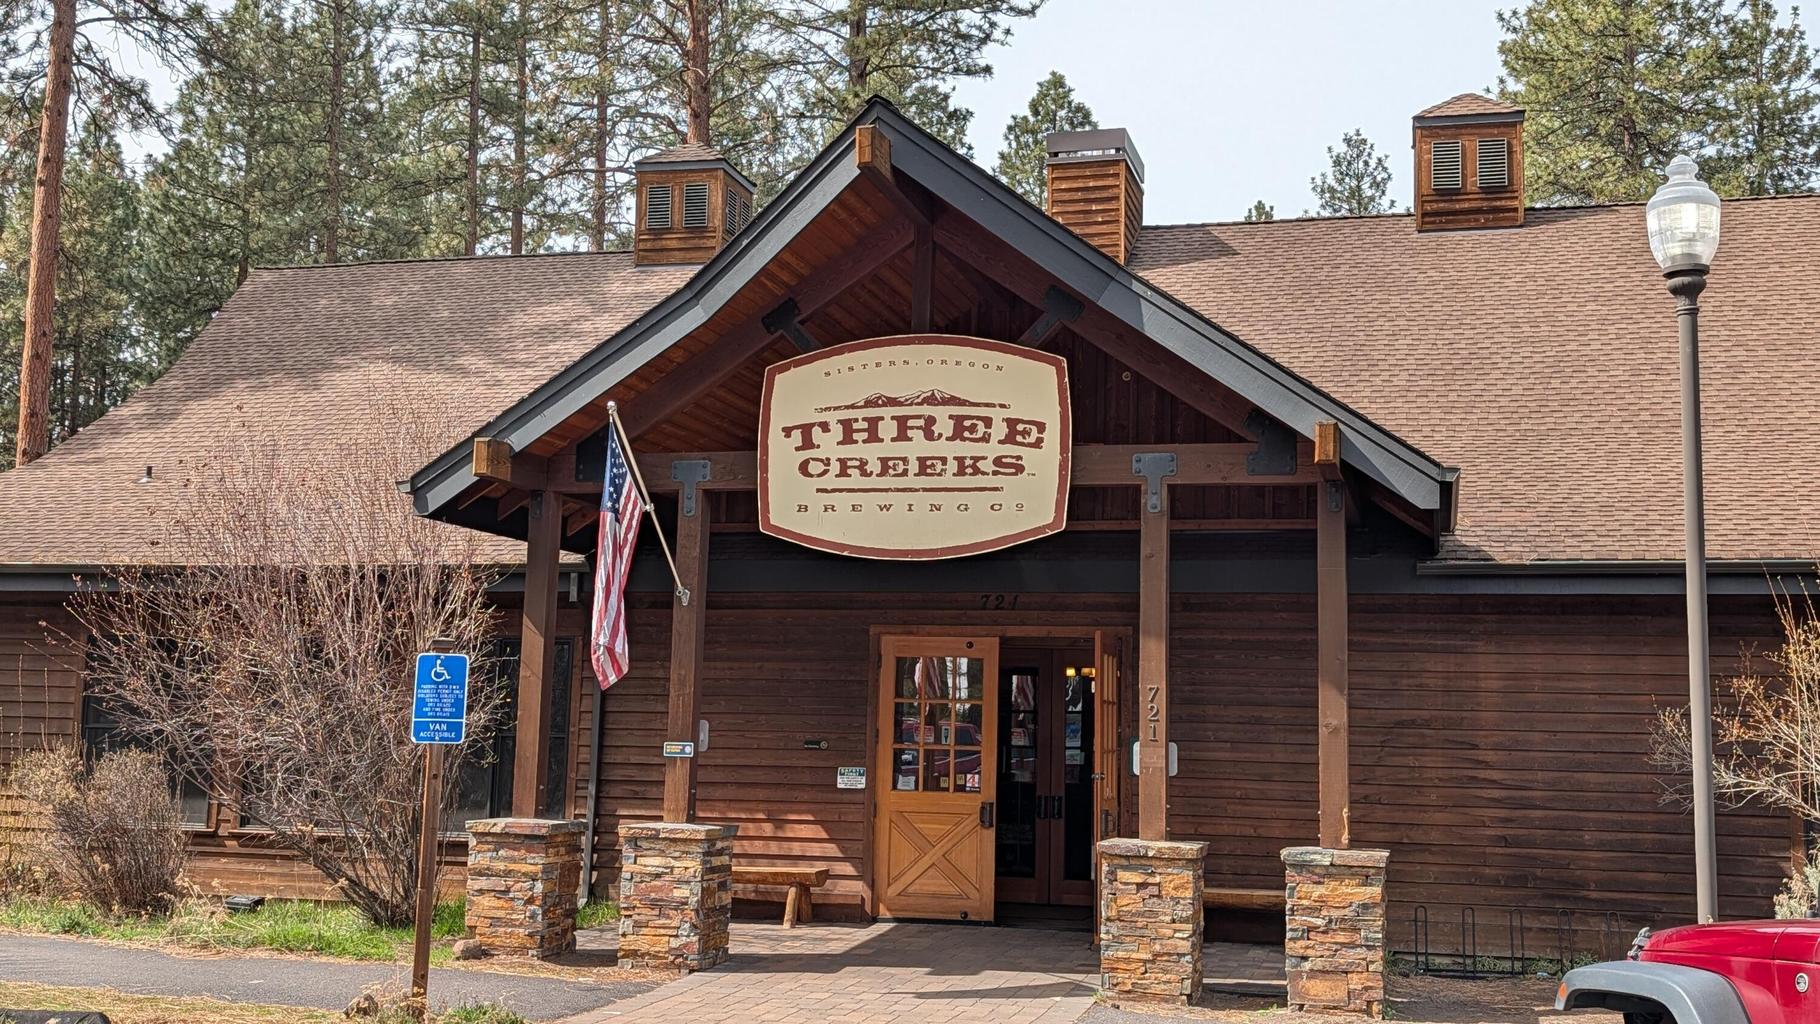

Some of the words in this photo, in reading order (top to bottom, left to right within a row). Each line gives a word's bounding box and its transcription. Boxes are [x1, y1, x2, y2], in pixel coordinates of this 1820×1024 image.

[926, 358, 1005, 373] OREGON
[781, 413, 1047, 452] THREE
[797, 454, 1026, 479] CREEKS
[796, 503, 970, 513] BREWING
[980, 594, 1019, 610] 721
[1146, 685, 1160, 742] 721
[429, 723, 447, 731] VAN
